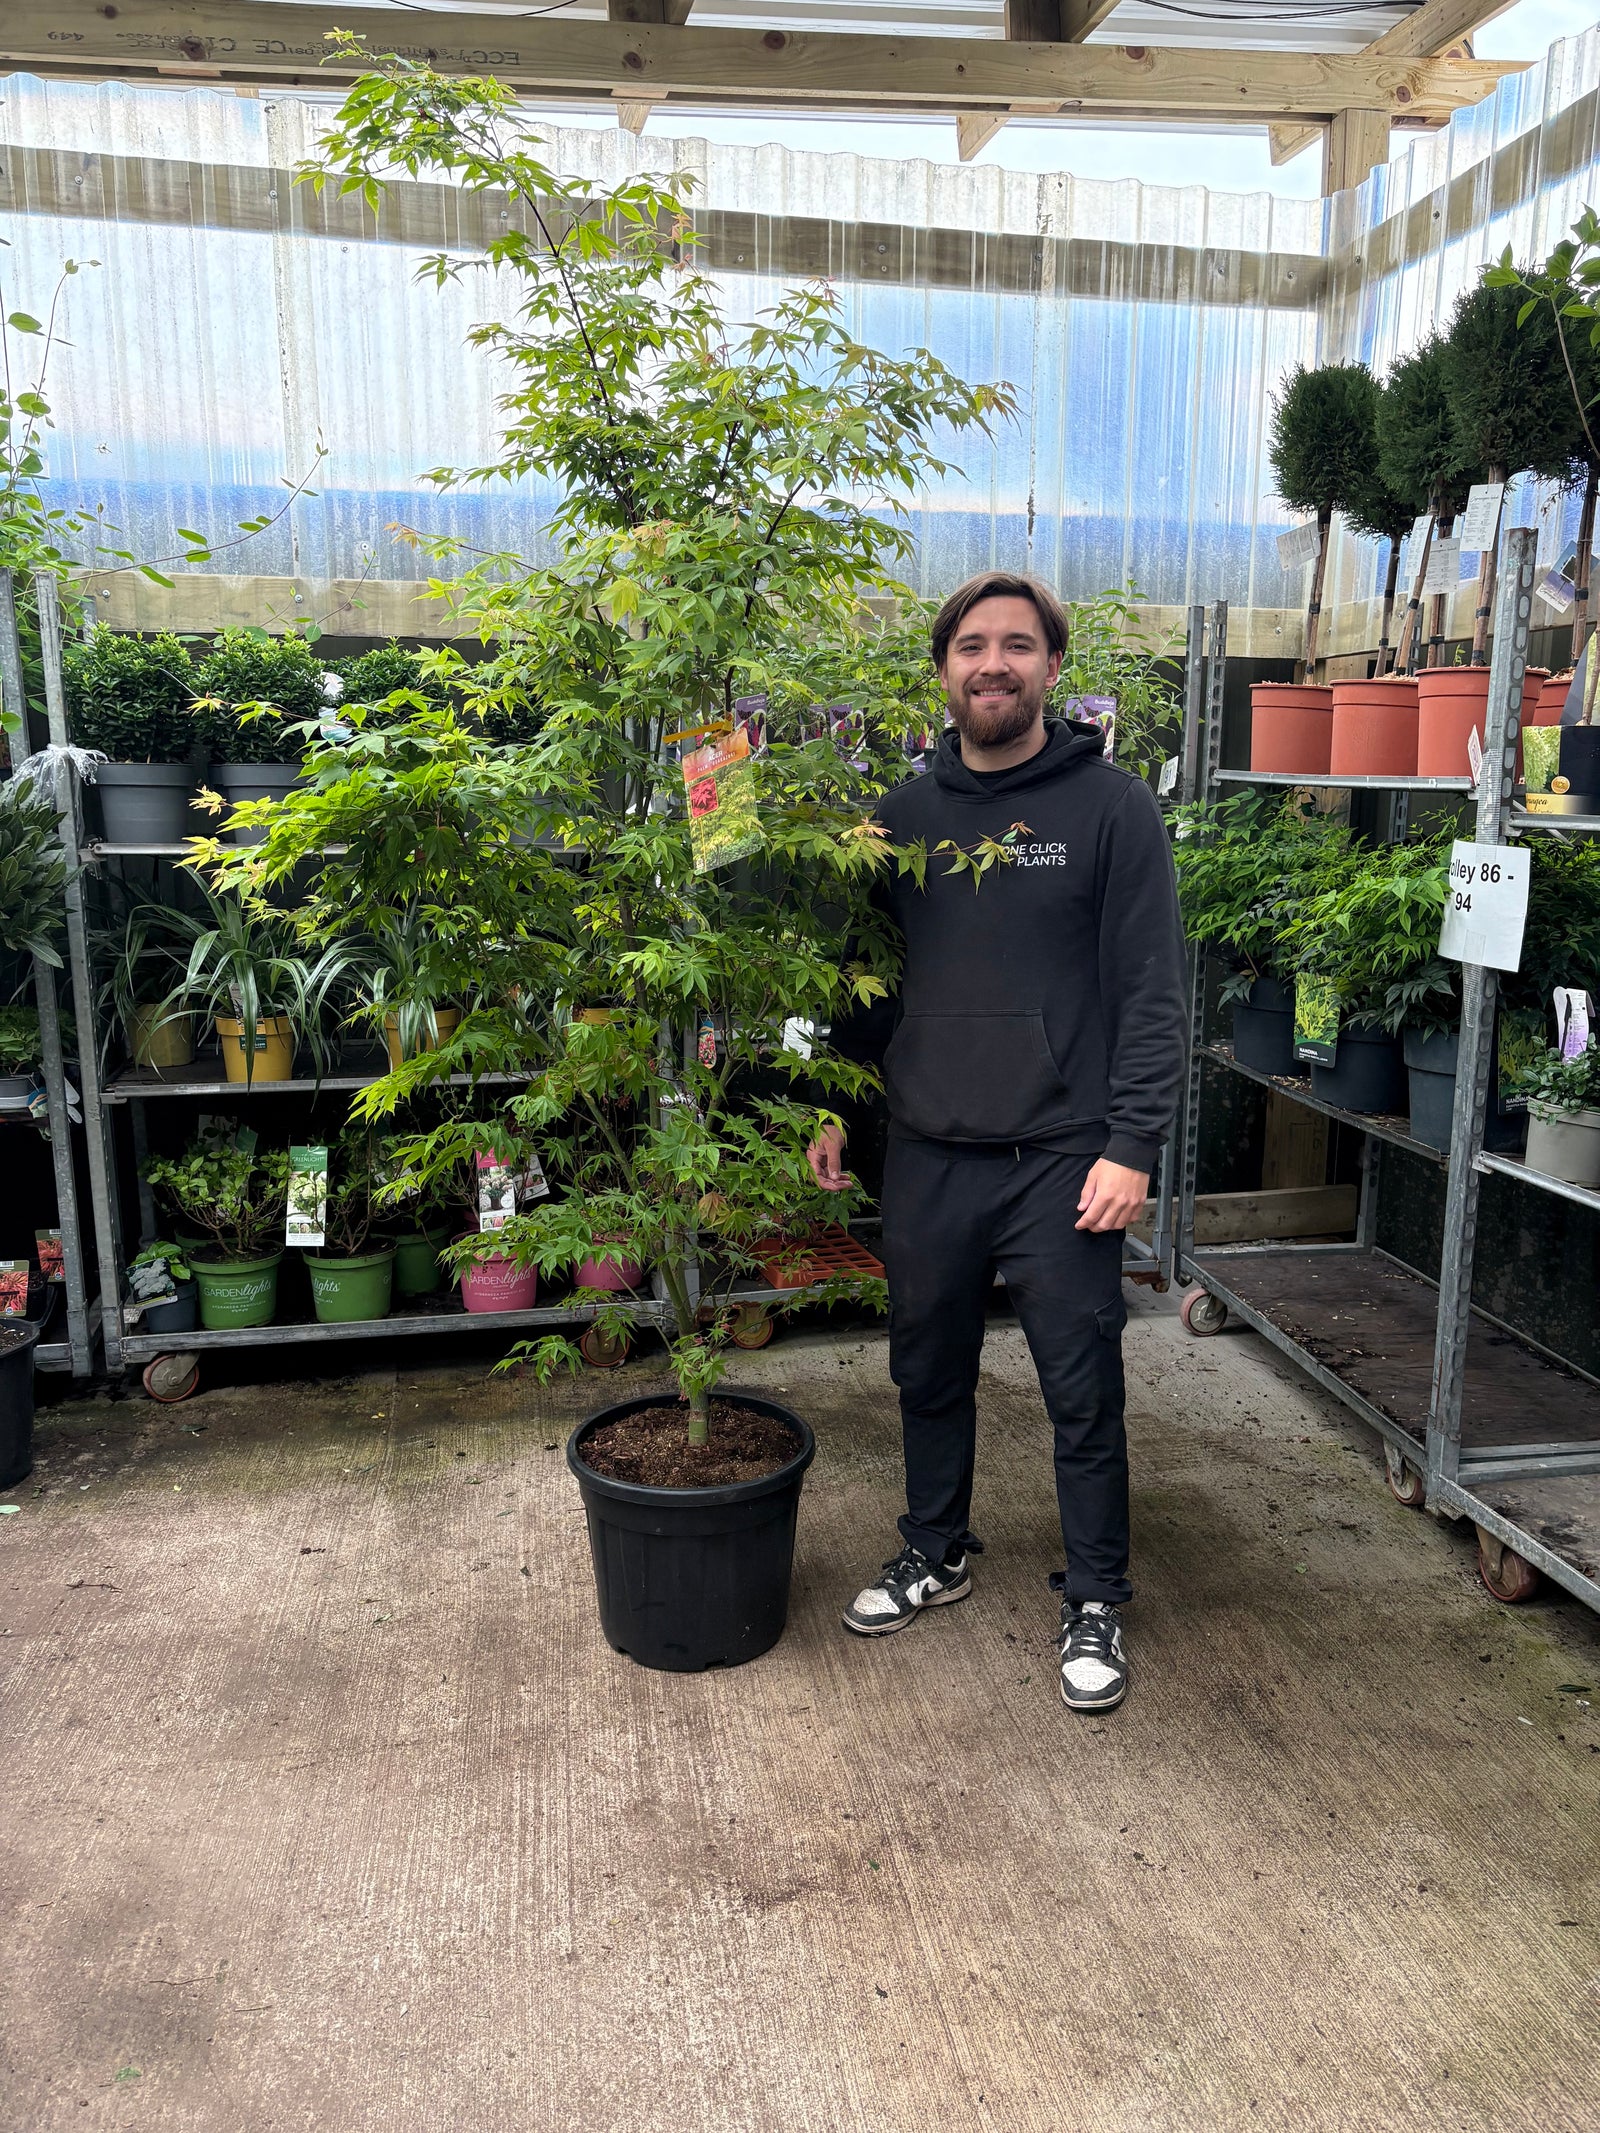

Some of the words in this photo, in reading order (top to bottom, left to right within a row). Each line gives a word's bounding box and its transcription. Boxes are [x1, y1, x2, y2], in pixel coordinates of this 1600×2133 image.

[252, 39, 286, 55] CE
[472, 50, 521, 66] ECC
[1003, 844, 1027, 855] ONE
[1029, 842, 1067, 854] CLICK
[1016, 855, 1066, 867] PLANTS
[1480, 862, 1501, 883] 86
[1455, 892, 1472, 913] 94
